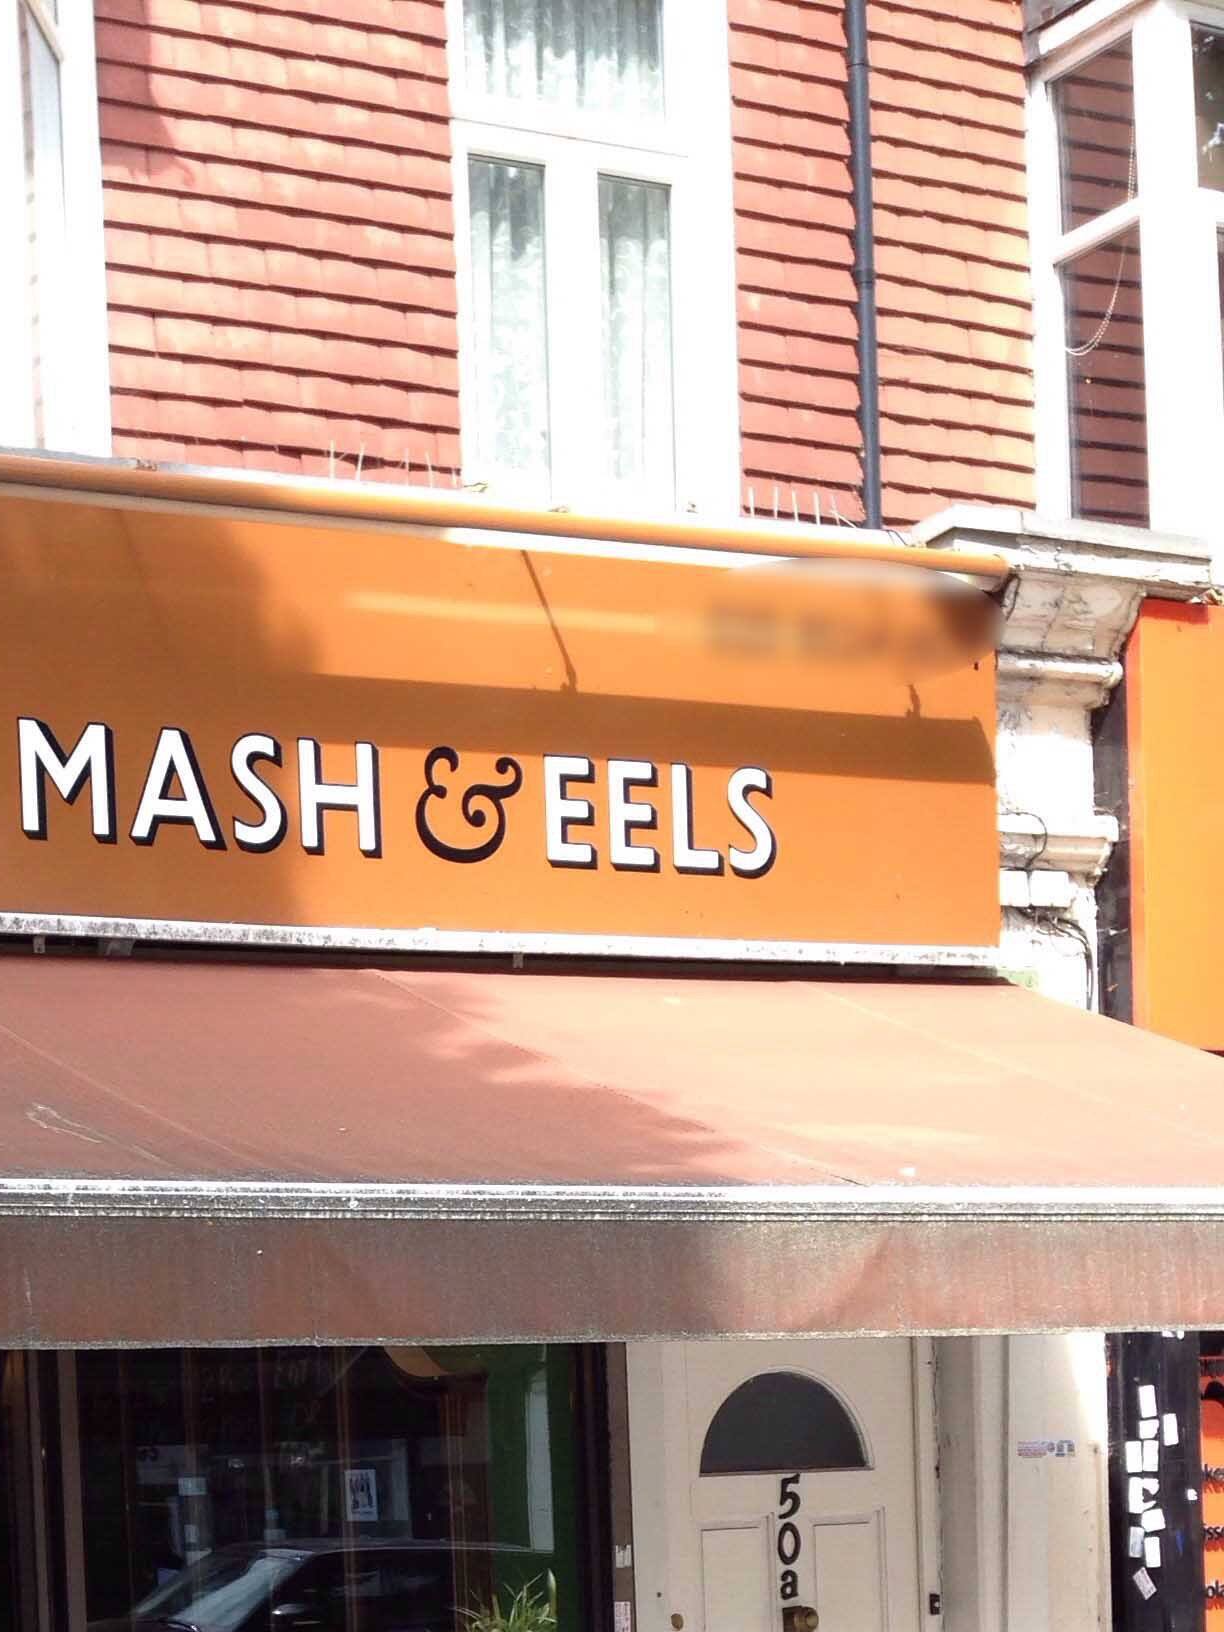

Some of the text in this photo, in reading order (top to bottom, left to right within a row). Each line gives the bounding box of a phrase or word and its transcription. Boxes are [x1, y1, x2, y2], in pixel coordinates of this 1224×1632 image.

[16, 717, 382, 860] MASH
[415, 745, 523, 864] &
[543, 754, 777, 879] EELS
